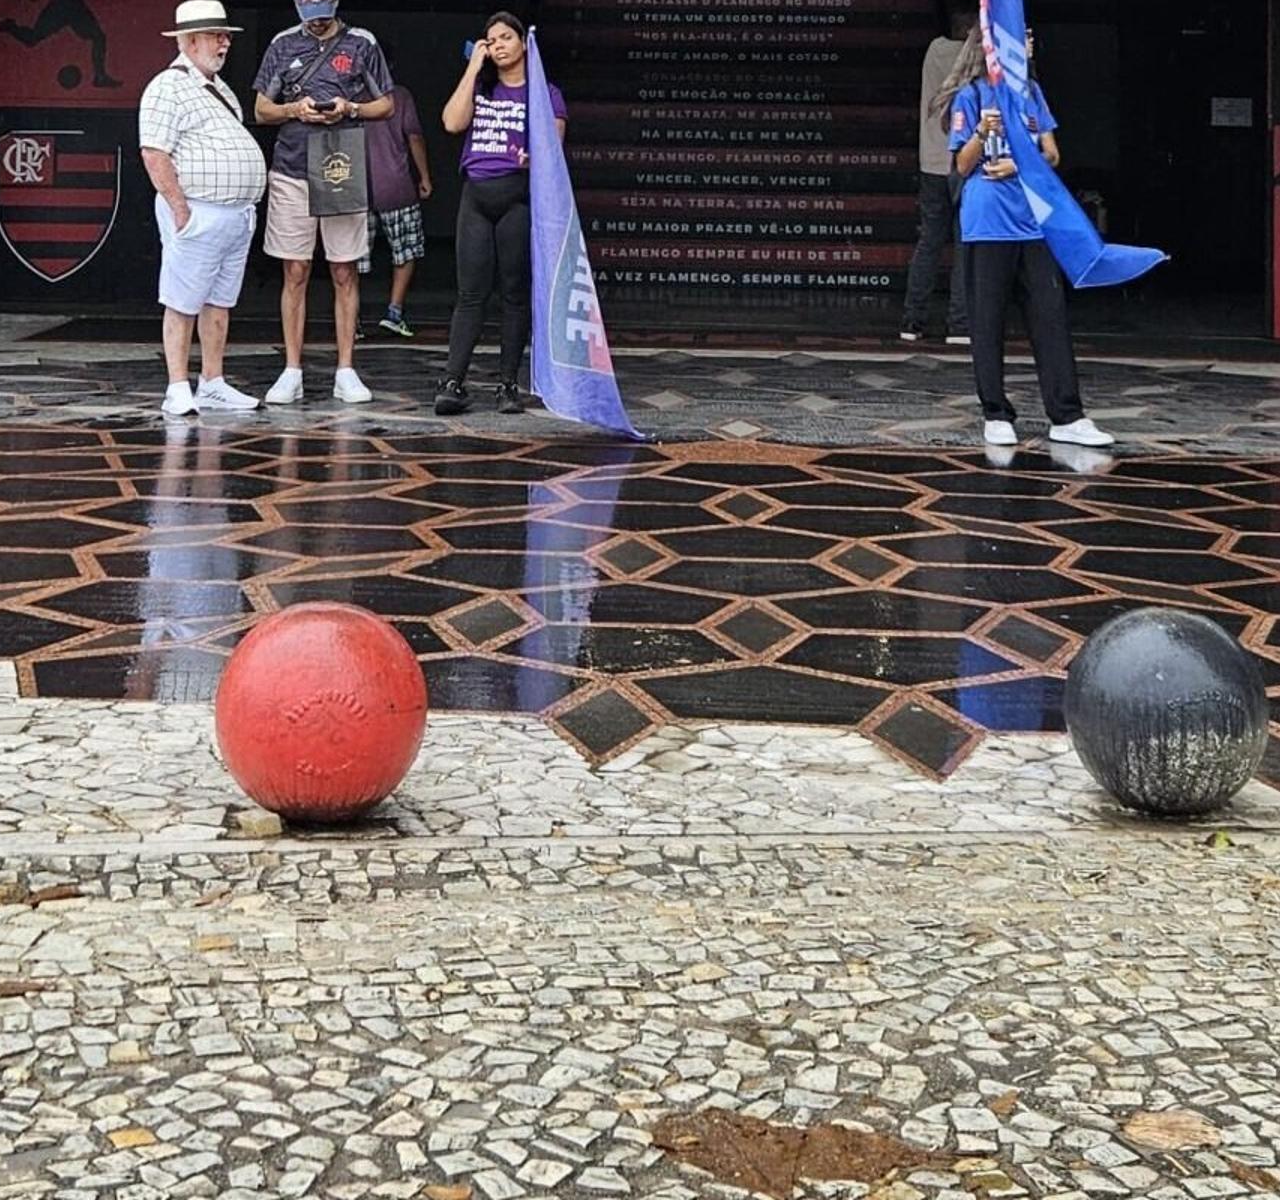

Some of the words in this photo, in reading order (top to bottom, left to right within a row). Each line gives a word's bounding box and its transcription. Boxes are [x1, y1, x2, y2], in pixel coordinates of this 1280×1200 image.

[623, 12, 639, 21] EU
[685, 13, 704, 22] UM
[627, 51, 680, 61] SEMPRE
[751, 52, 783, 61] MAIS
[638, 89, 665, 99] QUE
[730, 131, 754, 141] ELE
[760, 131, 780, 141] ME
[785, 132, 823, 141] MATA
[572, 151, 602, 161] UMA
[607, 151, 635, 161] VEZ
[726, 153, 802, 163] FLAMENGO
[662, 197, 683, 207] NA
[788, 200, 808, 209] NO
[814, 200, 845, 210] MAR
[606, 221, 637, 231] MEU
[642, 222, 690, 233] MAIOR
[695, 223, 753, 234] PRAZER
[759, 222, 804, 235] VÊ-LO
[809, 224, 874, 235] BRILHAR
[601, 247, 681, 258] FLAMENGO
[687, 249, 745, 260] SEMPRE
[751, 249, 771, 260] EU
[776, 249, 802, 260] HEI
[808, 250, 827, 260] DE
[832, 250, 862, 261] SER
[615, 272, 643, 282] VEZ
[649, 272, 736, 285] FLAMENGO,
[742, 273, 803, 284] SEMPRE
[808, 274, 891, 286] FLAMENGO
